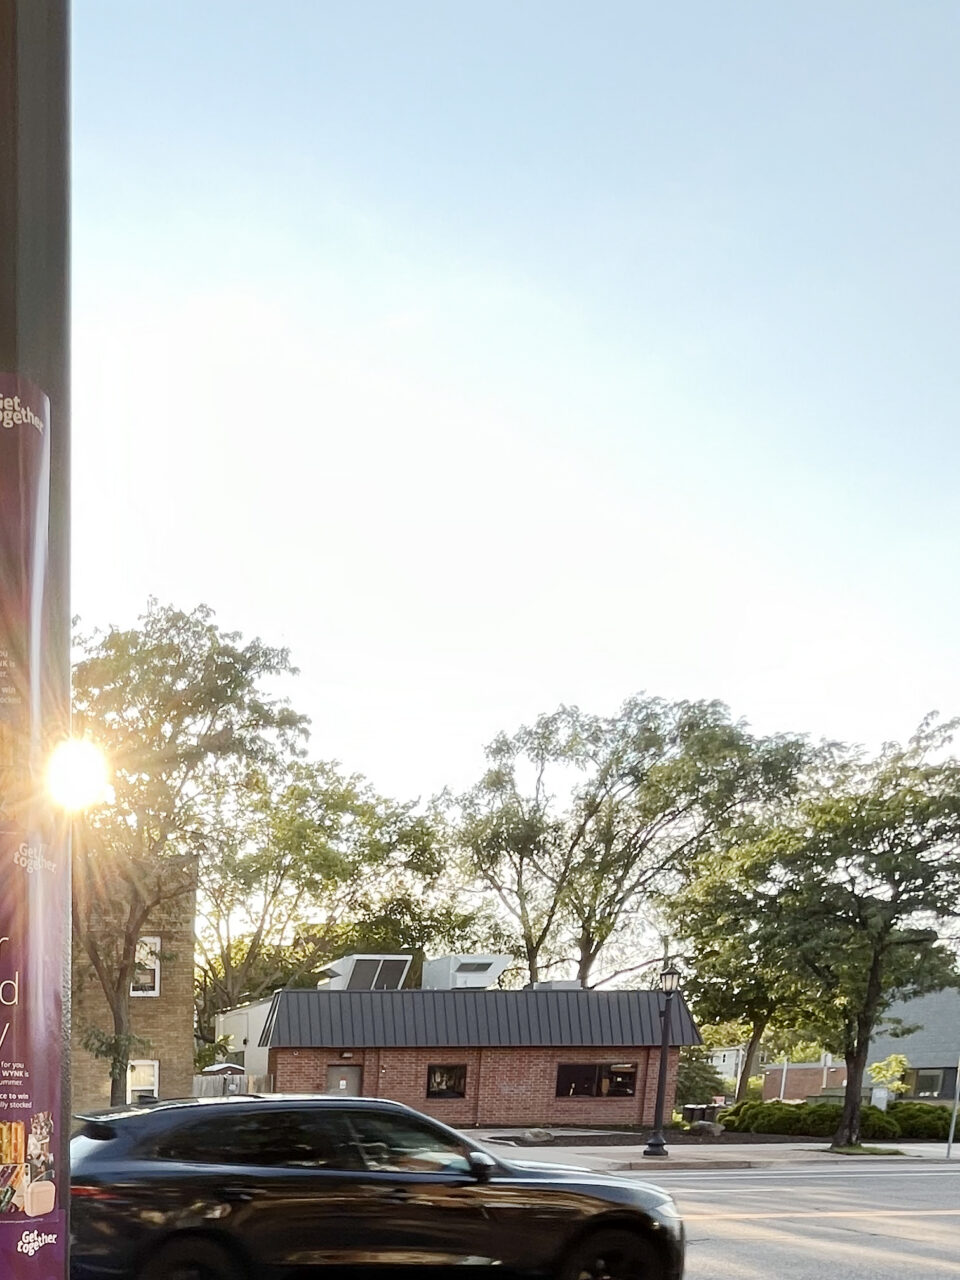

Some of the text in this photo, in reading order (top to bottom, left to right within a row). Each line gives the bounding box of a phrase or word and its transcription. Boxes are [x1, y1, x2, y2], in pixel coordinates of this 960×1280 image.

[2, 686, 16, 695] win
[12, 1062, 25, 1070] you
[22, 1229, 39, 1244] Get
[17, 1233, 58, 1257] together
